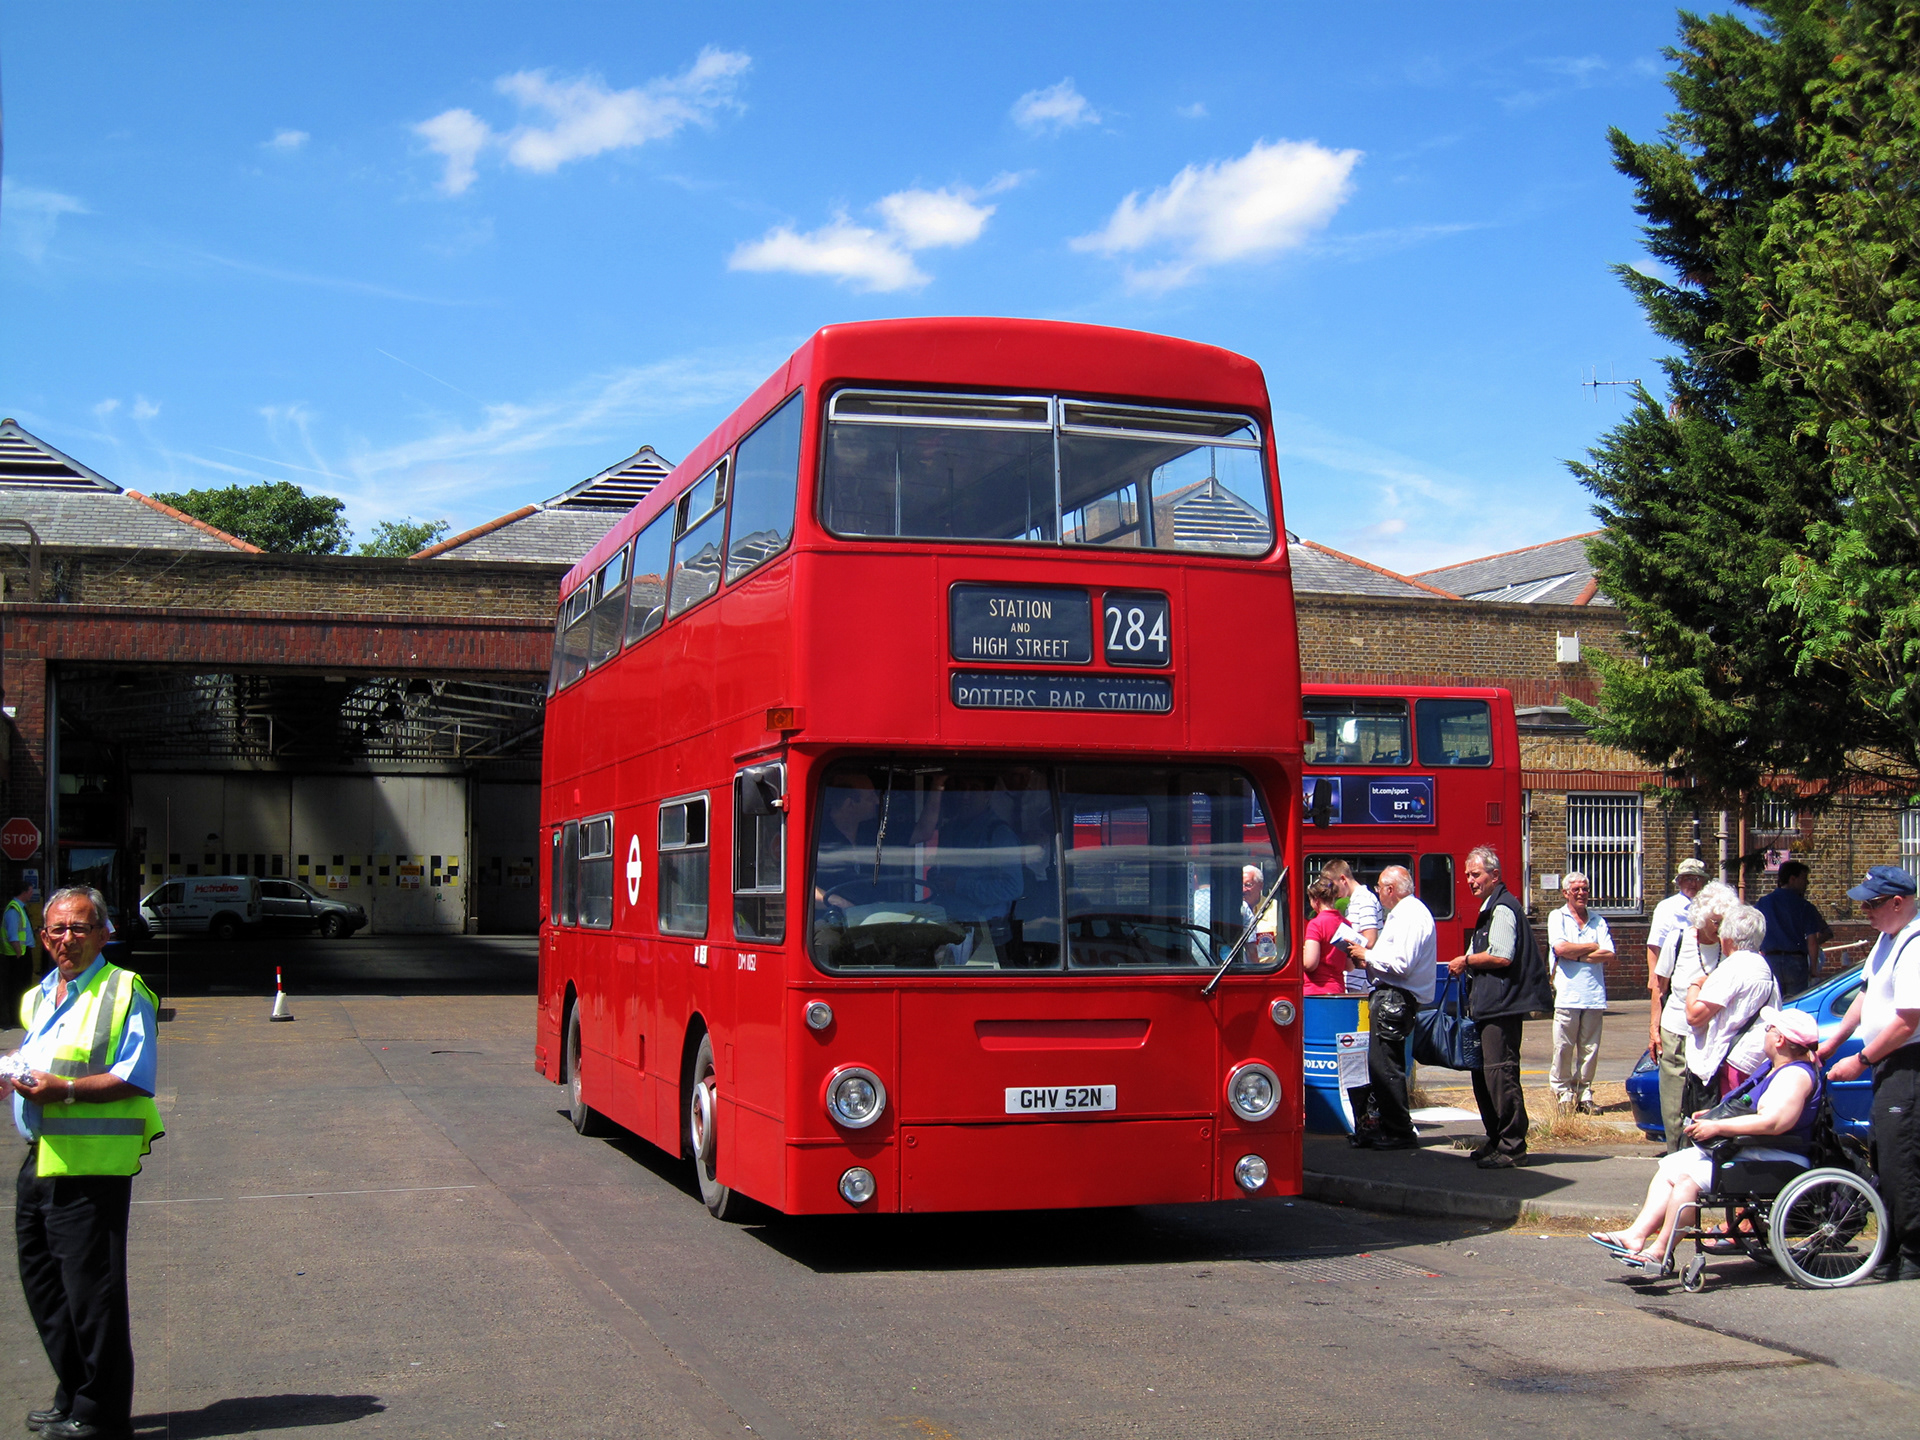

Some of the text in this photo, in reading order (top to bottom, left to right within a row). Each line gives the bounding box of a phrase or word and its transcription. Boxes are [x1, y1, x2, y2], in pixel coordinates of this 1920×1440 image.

[989, 598, 1051, 619] STATION
[1010, 622, 1030, 633] AND
[1105, 607, 1167, 652] 284
[973, 636, 1069, 658] HIGH STREET
[958, 687, 1166, 710] POTTERS BAR STATION
[1372, 787, 1409, 795] bt.com/sport
[1393, 801, 1410, 810] BT
[3, 833, 36, 845] STOP
[194, 883, 239, 893] Metroline
[1020, 1088, 1102, 1109] GHV 52N
